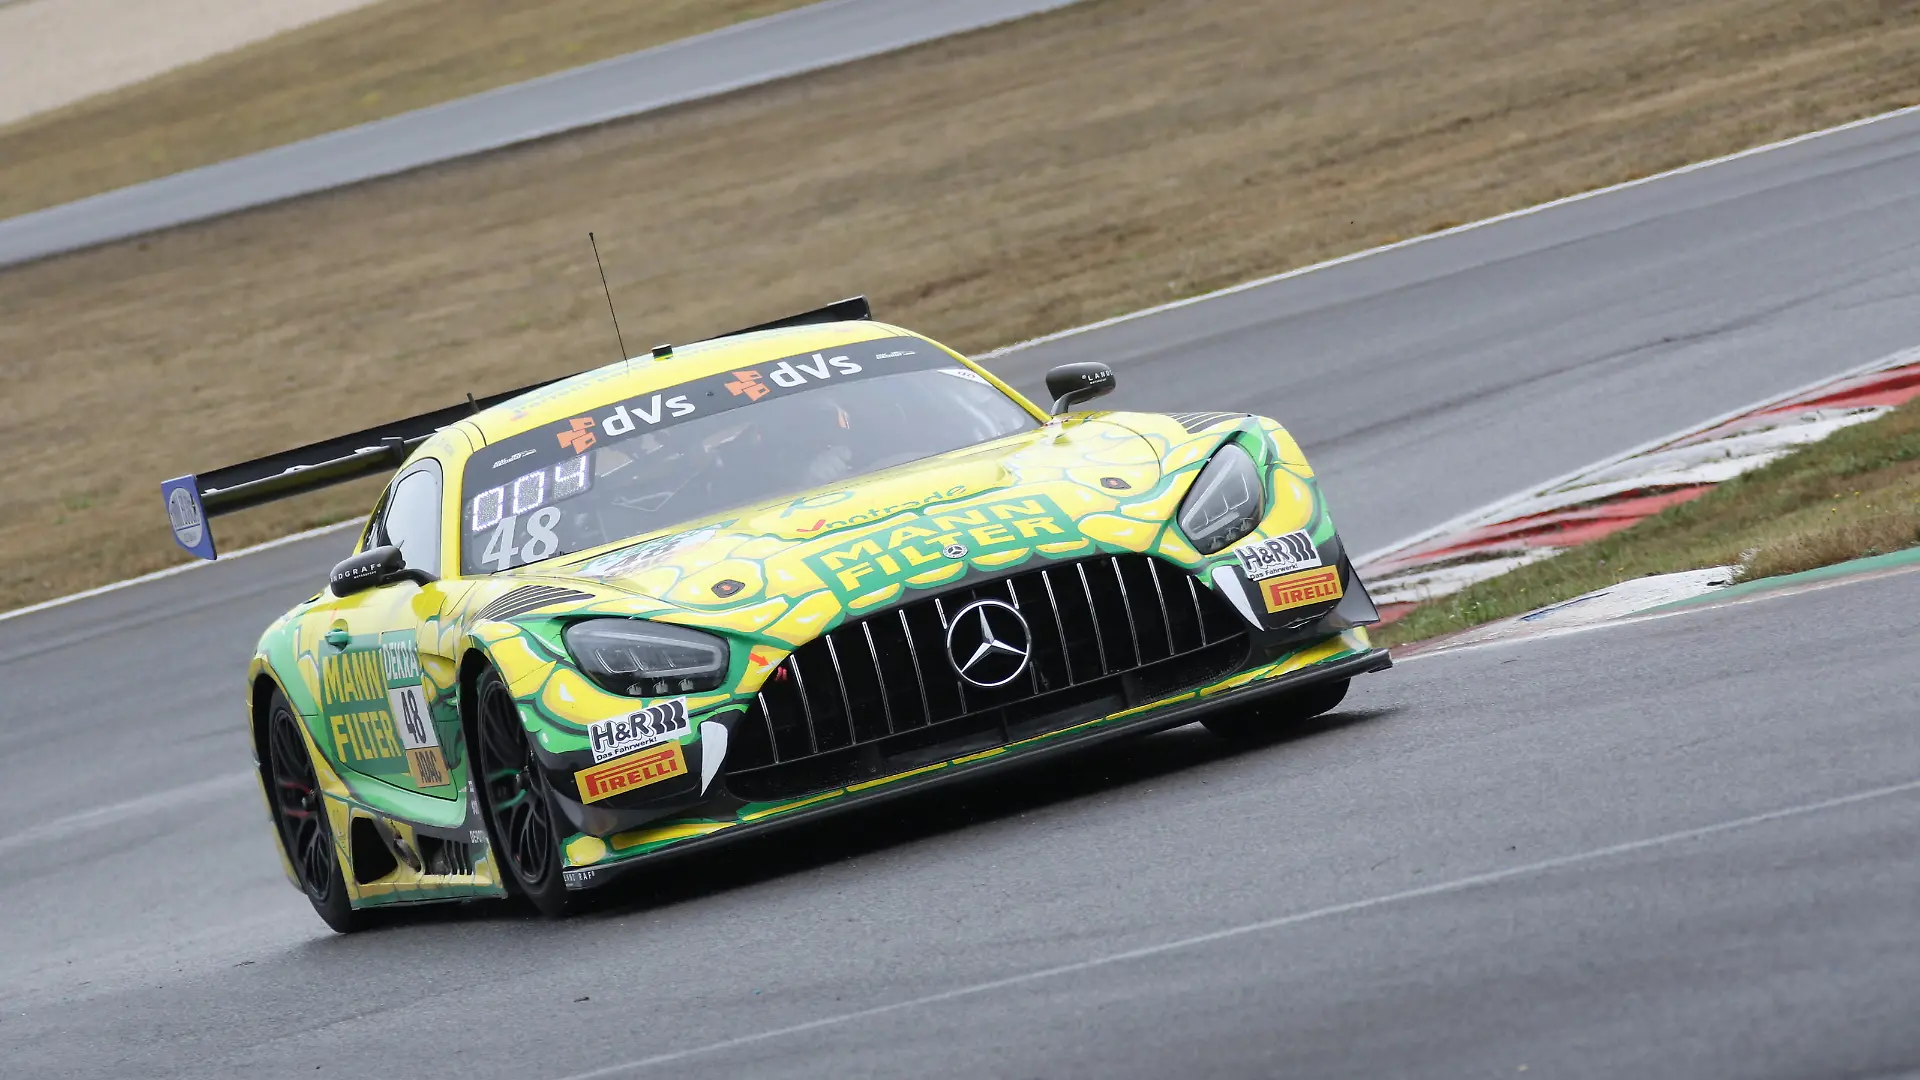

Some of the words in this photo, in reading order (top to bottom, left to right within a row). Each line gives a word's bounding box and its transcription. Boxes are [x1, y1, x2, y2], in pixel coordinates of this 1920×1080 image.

[769, 353, 862, 388] dvs
[601, 393, 696, 437] dvs
[481, 506, 561, 571] 48
[820, 500, 1046, 571] MANN
[836, 517, 1065, 591] FILTER
[1236, 541, 1292, 573] H&R
[1265, 563, 1298, 575] Fahrwerk!
[1270, 572, 1337, 607] PIRELLI
[323, 650, 384, 704] MANN
[383, 640, 419, 680] DEKRA
[330, 711, 402, 762] FILTER
[401, 689, 427, 743] 48
[591, 711, 656, 753] H&R
[415, 750, 442, 783] ADAC
[596, 752, 613, 761] Das
[615, 737, 657, 754] Fahrwerk!
[585, 749, 678, 797] PIRELLI
